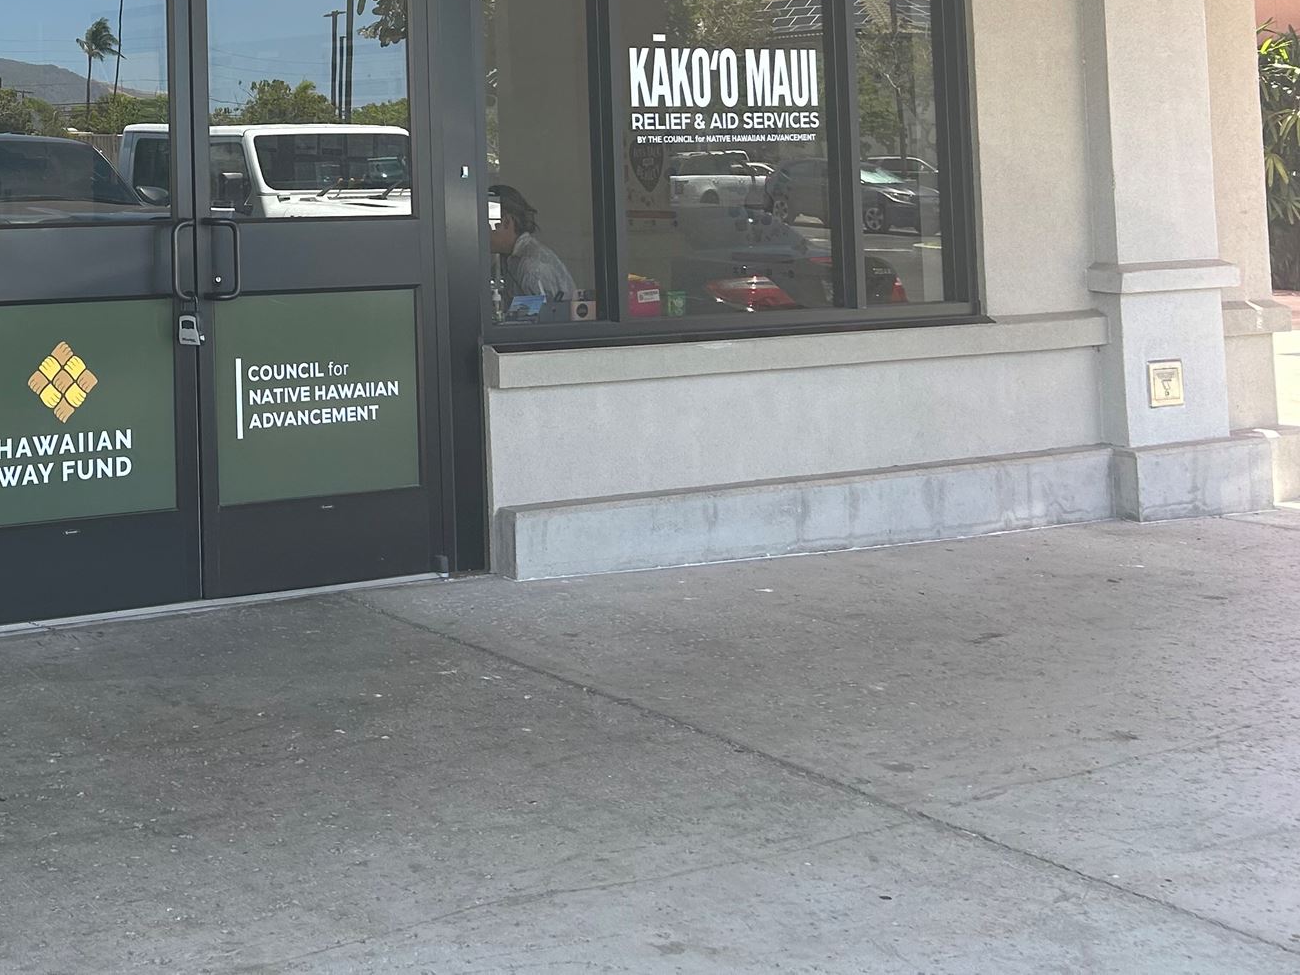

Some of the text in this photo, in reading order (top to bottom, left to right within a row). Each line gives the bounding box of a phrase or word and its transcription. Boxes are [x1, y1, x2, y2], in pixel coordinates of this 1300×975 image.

[745, 48, 819, 107] MAUI
[631, 112, 820, 130] RELIEF & AID SERVICES
[637, 133, 816, 144] BY THE COUNCIL for NATIVE HAWAIIAN ADVANCEMENT
[248, 361, 349, 382] COUNCIL for
[248, 381, 399, 406] NATIVE HAWAIIAN
[248, 404, 379, 430] ADVANCEMENT
[62, 455, 133, 482] FUND
